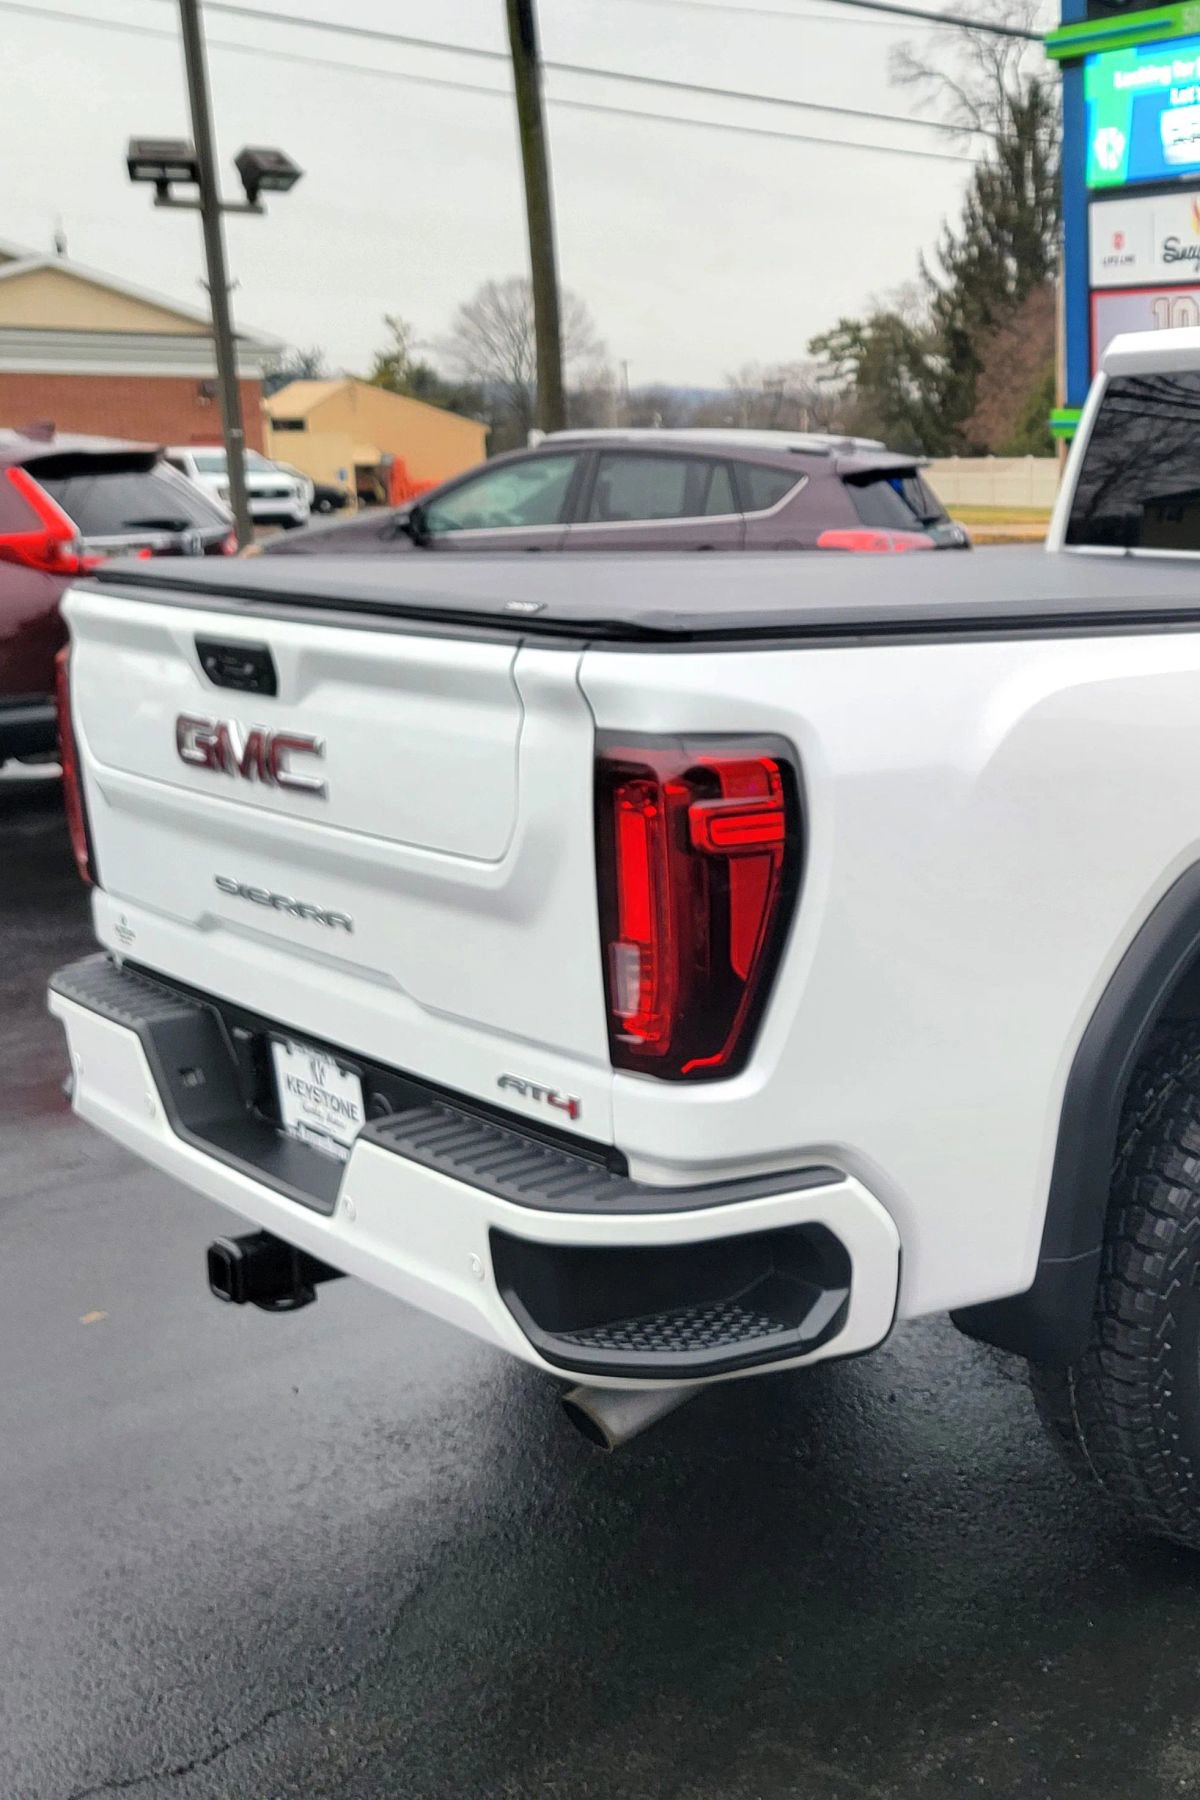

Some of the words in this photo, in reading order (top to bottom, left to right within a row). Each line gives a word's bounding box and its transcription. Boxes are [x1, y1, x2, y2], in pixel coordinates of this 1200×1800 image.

[176, 713, 328, 801] GMC
[214, 874, 354, 934] SIERRA
[286, 1074, 360, 1121] KEYSTONE
[497, 1072, 582, 1121] AT4
